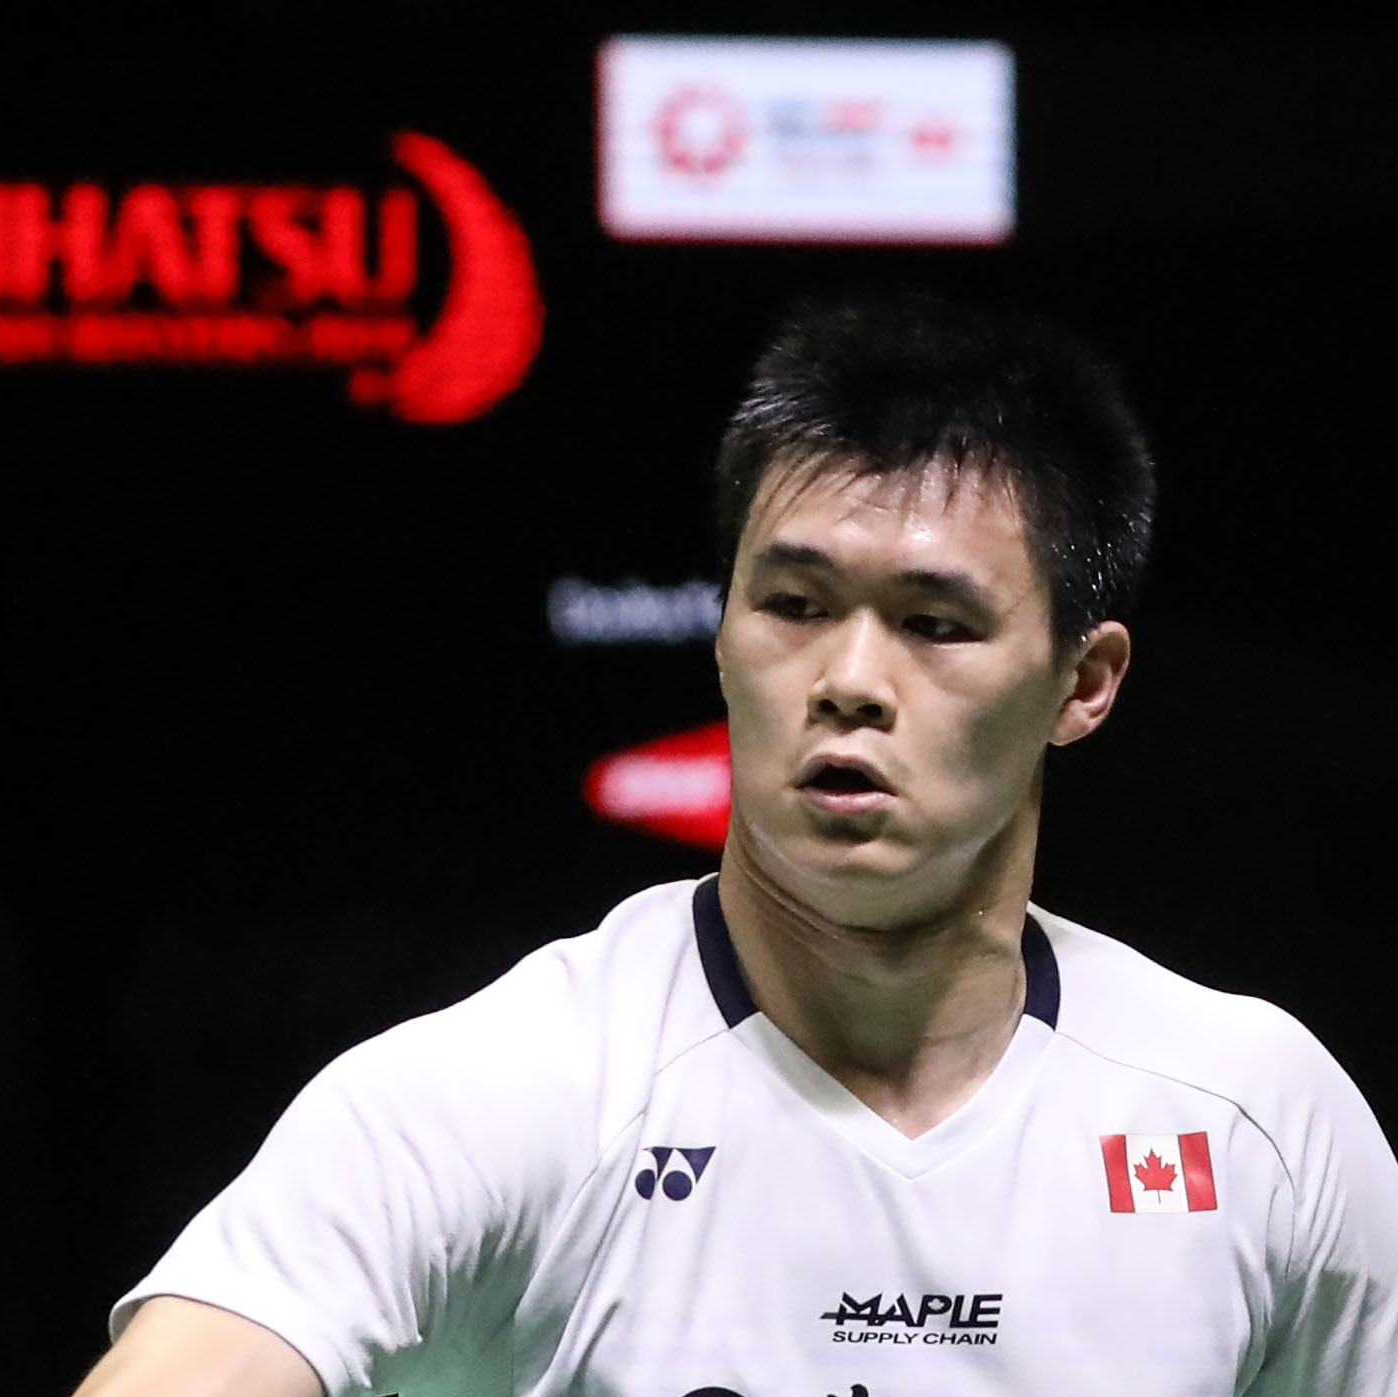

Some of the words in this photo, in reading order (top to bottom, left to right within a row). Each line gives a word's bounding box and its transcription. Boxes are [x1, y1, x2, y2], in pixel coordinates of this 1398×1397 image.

[819, 1291, 1003, 1328] MAPLE
[832, 1331, 919, 1344] SUPPLY
[922, 1333, 998, 1345] CHAIN
